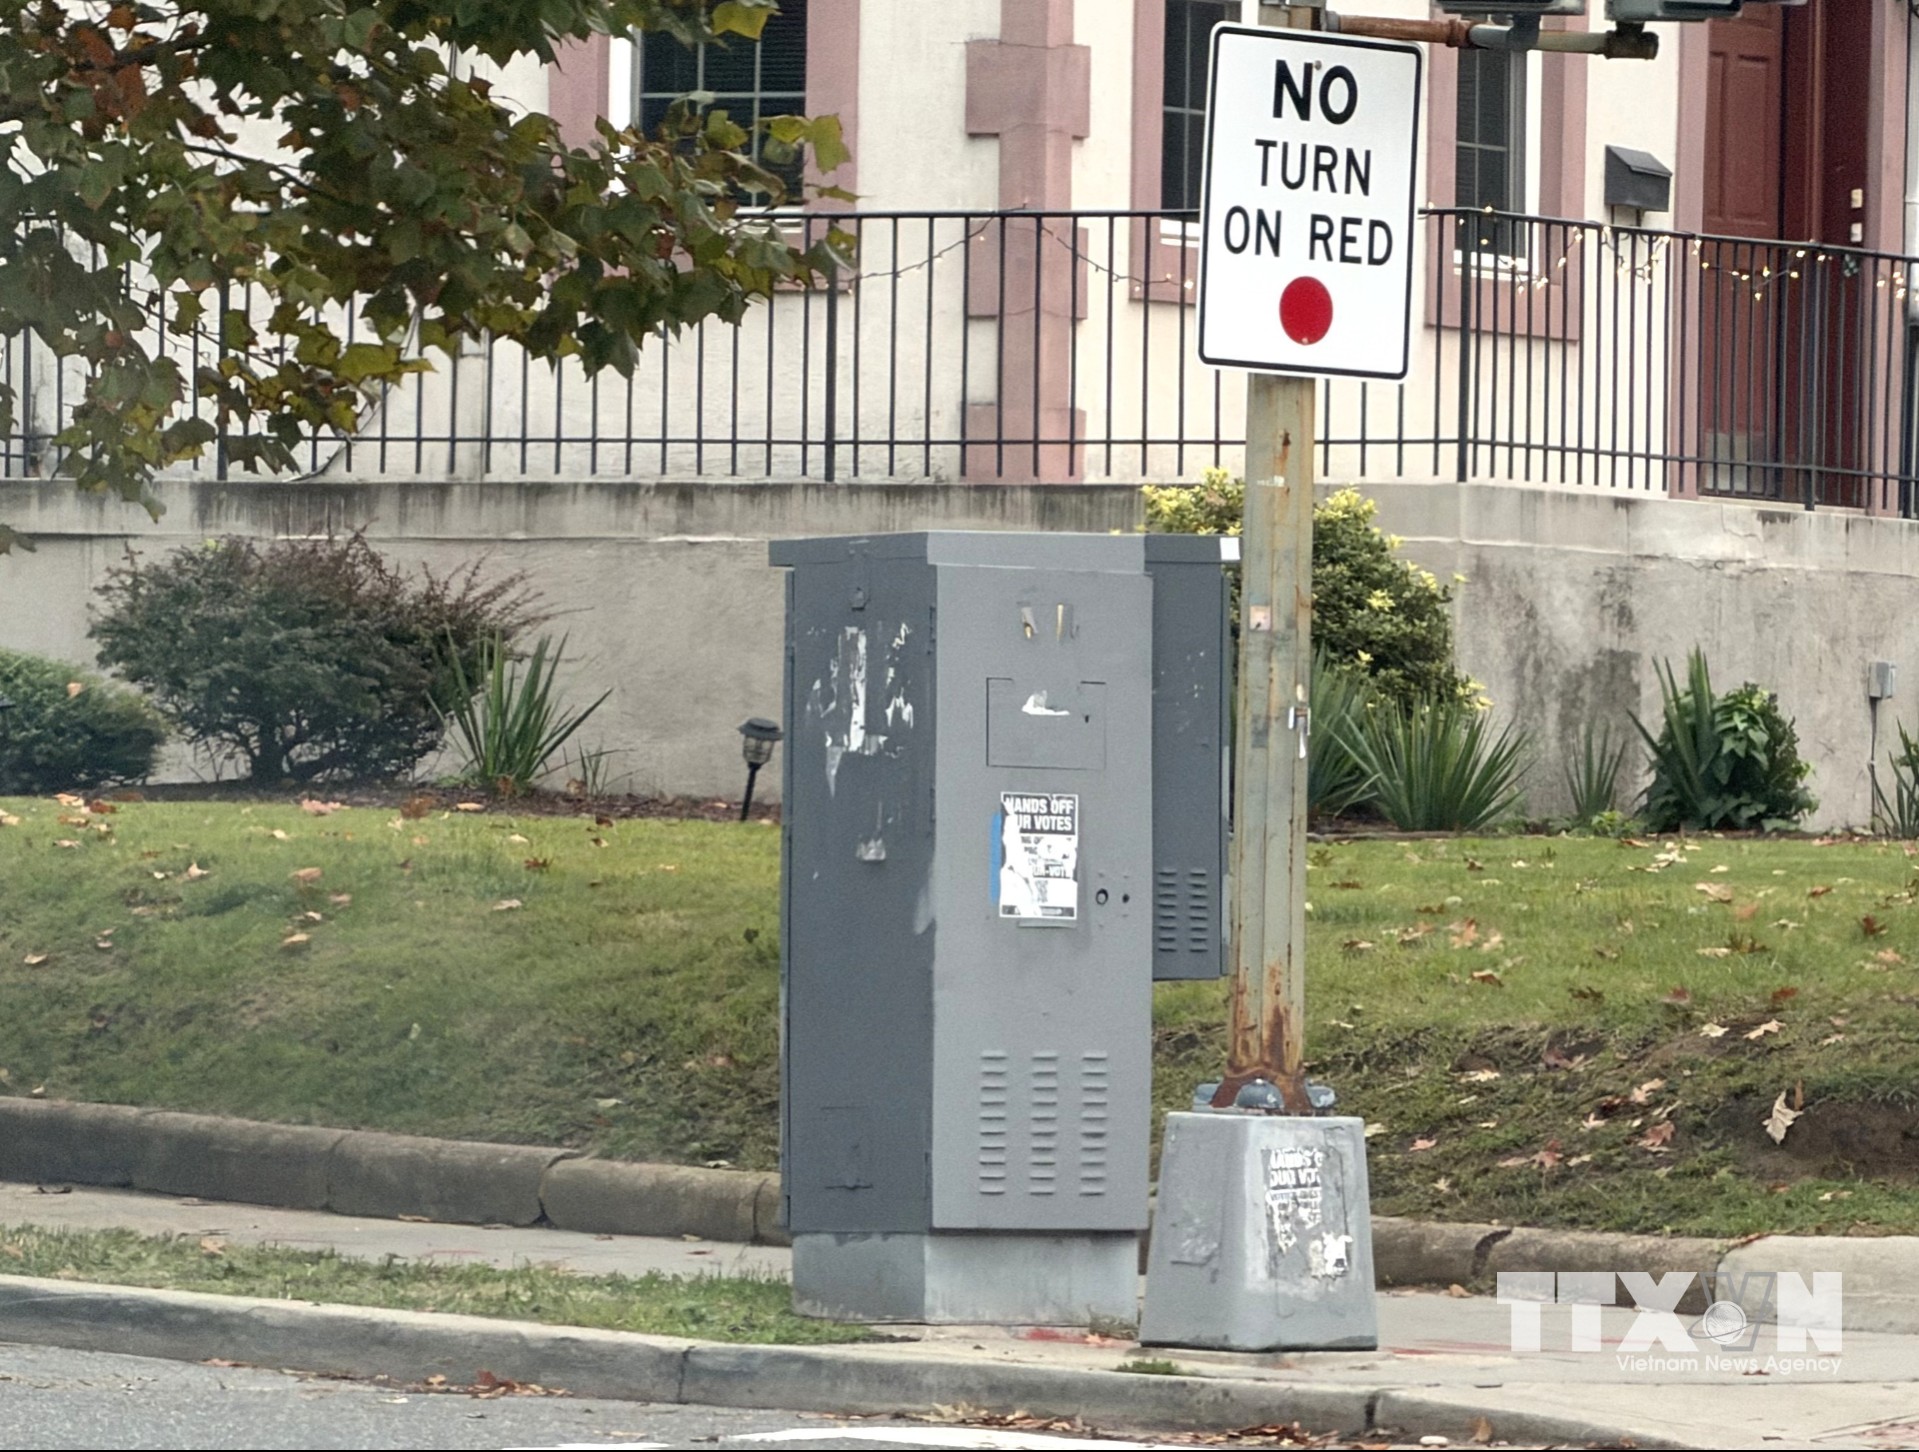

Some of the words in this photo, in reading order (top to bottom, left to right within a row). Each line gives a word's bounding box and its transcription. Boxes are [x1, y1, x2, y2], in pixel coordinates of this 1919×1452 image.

[1272, 58, 1358, 125] NO
[1254, 138, 1372, 197] TURN
[1223, 205, 1282, 258] ON
[1308, 213, 1393, 266] RED
[1033, 815, 1072, 831] VOTES
[1050, 799, 1074, 815] OFF
